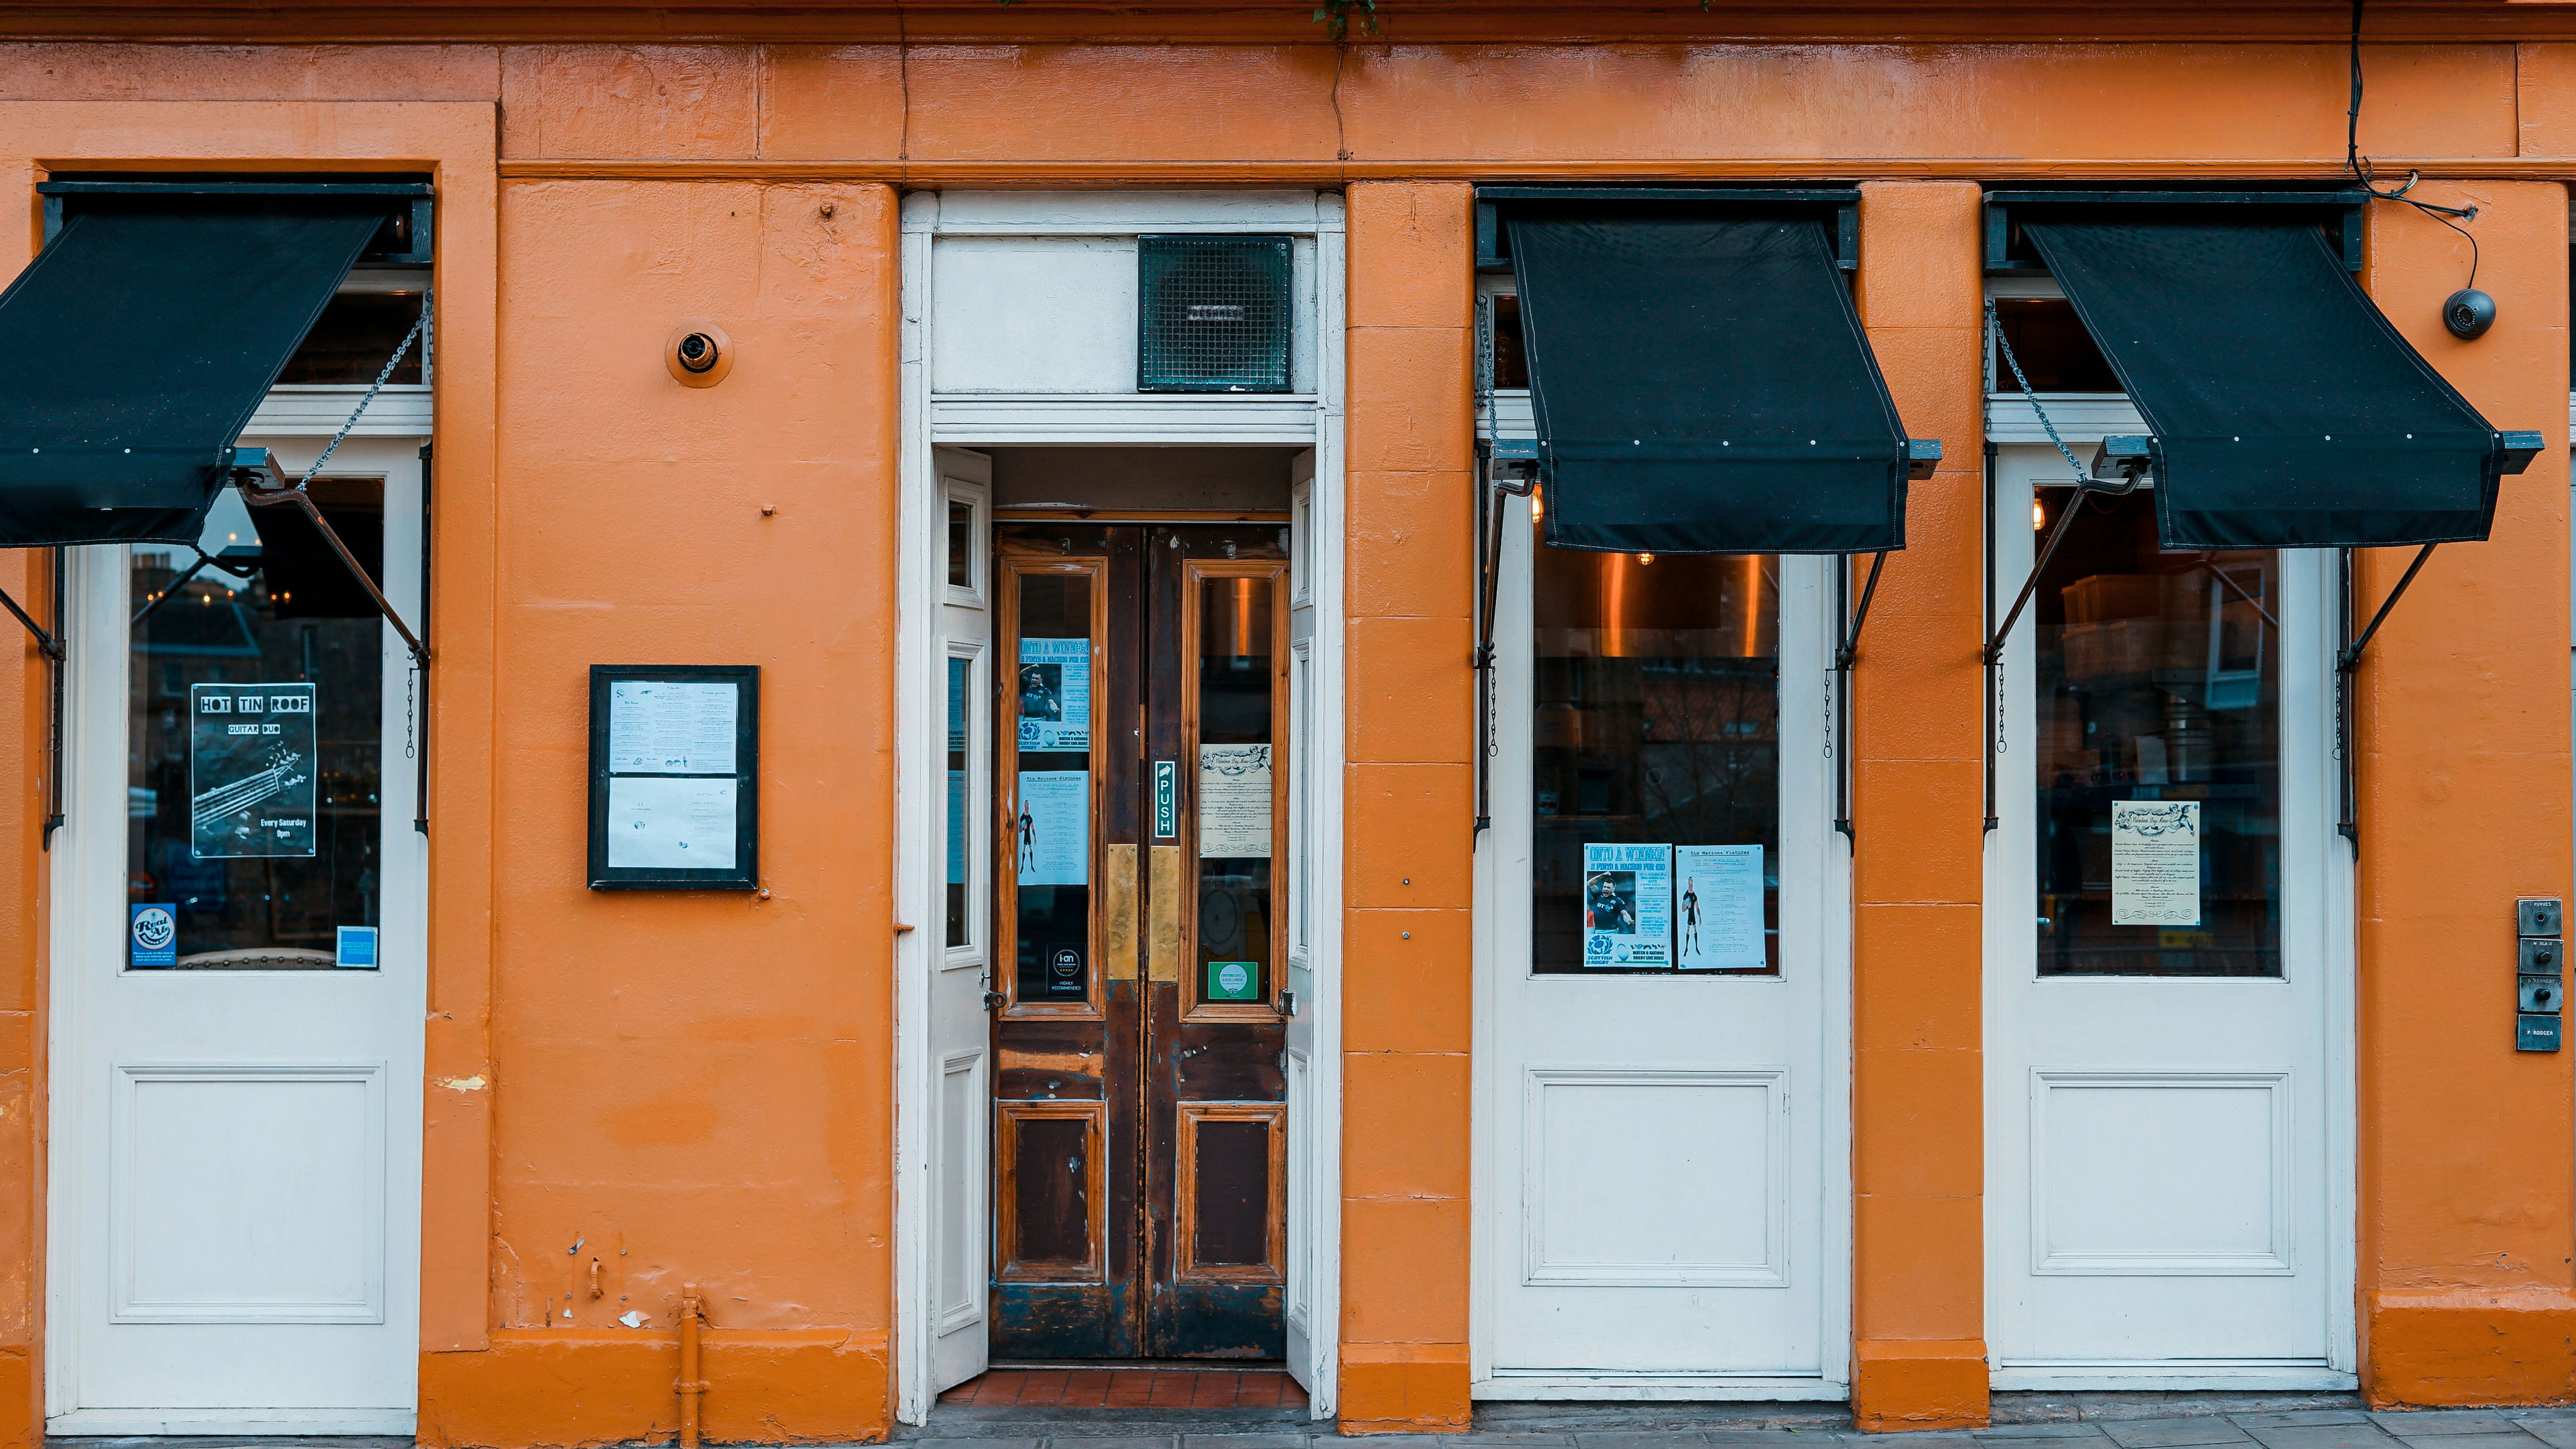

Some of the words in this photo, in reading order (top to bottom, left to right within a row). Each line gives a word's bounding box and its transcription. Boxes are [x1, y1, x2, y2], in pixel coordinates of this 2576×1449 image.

[1021, 641, 1041, 655] ONTO
[1043, 641, 1050, 655] A
[1052, 641, 1089, 655] WINNER!
[202, 697, 230, 711] HOT
[240, 697, 262, 711] TIN
[271, 697, 309, 711] ROOF
[228, 725, 258, 734] GUITAR
[262, 725, 279, 734] DUO
[1160, 780, 1170, 831] PUSH
[260, 818, 279, 828] Every
[279, 818, 307, 828] Saturday
[277, 829, 291, 839] 9pm
[1590, 846, 1614, 862] ONTO
[1615, 846, 1623, 862] A
[1625, 846, 1665, 862] WINNER!
[136, 917, 167, 933] Real
[150, 925, 171, 937] Ale
